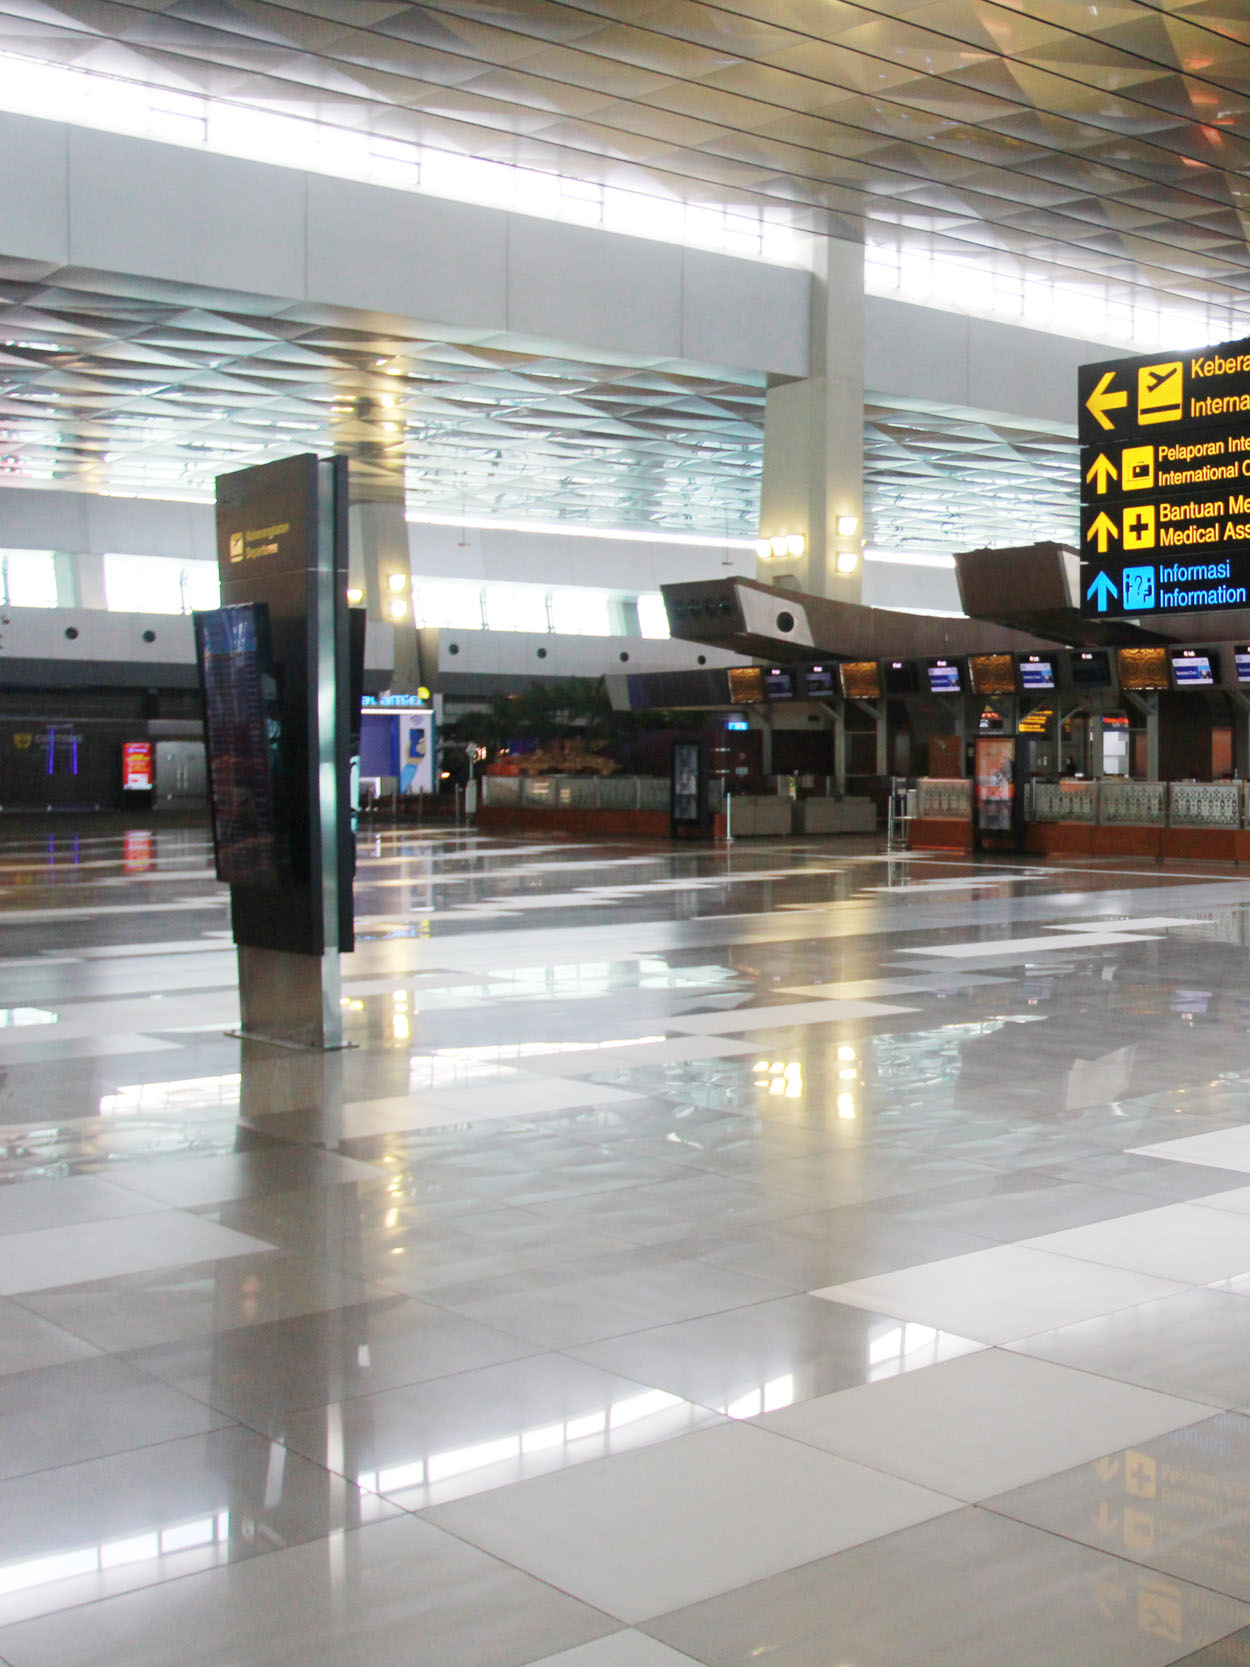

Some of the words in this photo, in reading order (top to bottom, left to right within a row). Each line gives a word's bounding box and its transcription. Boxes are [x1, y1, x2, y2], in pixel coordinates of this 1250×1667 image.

[1158, 441, 1225, 462] Pelaporan
[1158, 461, 1239, 486] International
[1160, 501, 1225, 522] Bantuan
[1160, 523, 1220, 546] Medical
[1160, 559, 1231, 583] Informasi
[1160, 585, 1247, 607] Information
